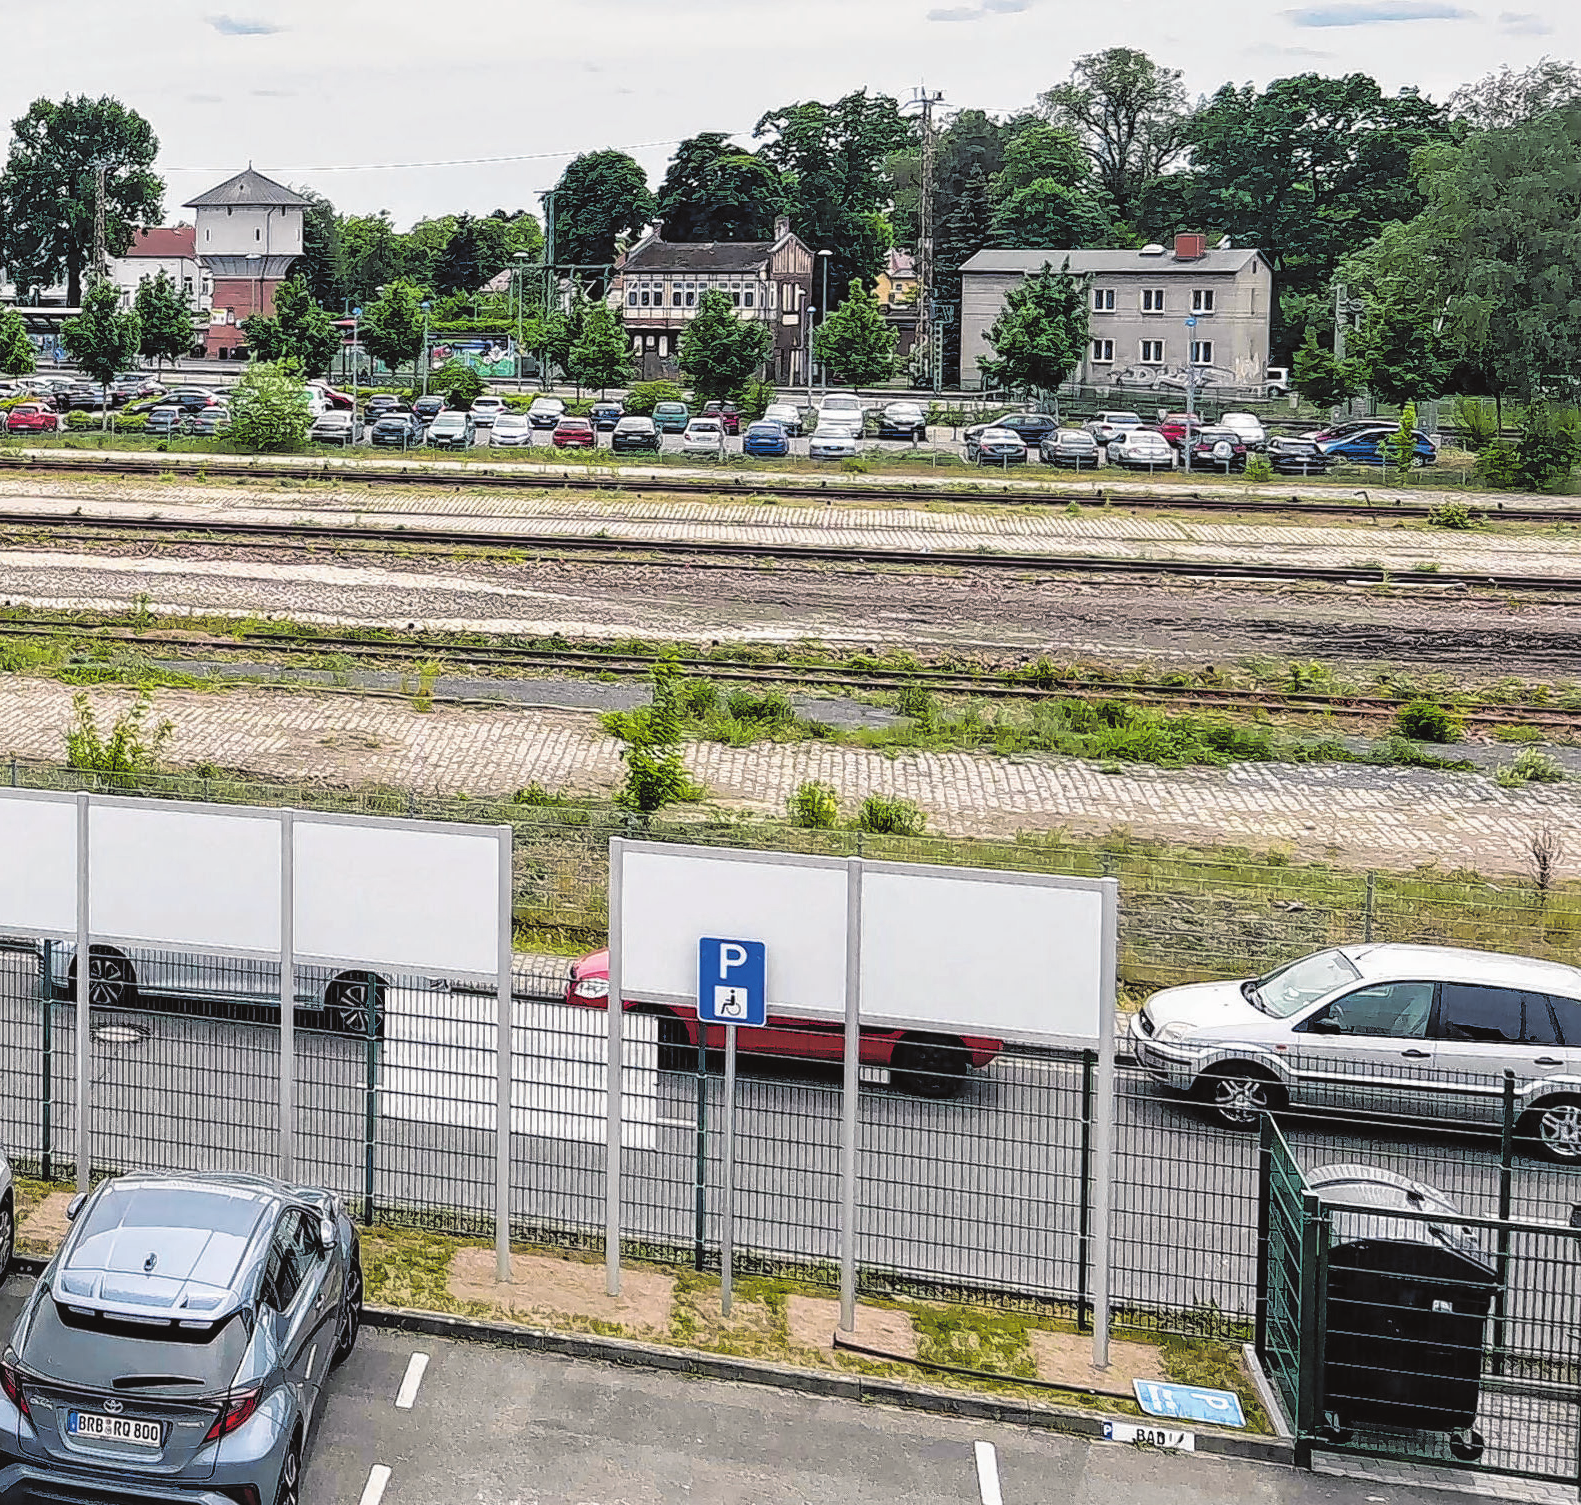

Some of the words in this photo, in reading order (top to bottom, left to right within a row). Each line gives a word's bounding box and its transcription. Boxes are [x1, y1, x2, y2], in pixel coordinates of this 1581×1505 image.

[720, 942, 747, 979] P
[78, 1415, 103, 1433] BRB
[113, 1420, 130, 1437] RQ
[133, 1423, 158, 1441] 800
